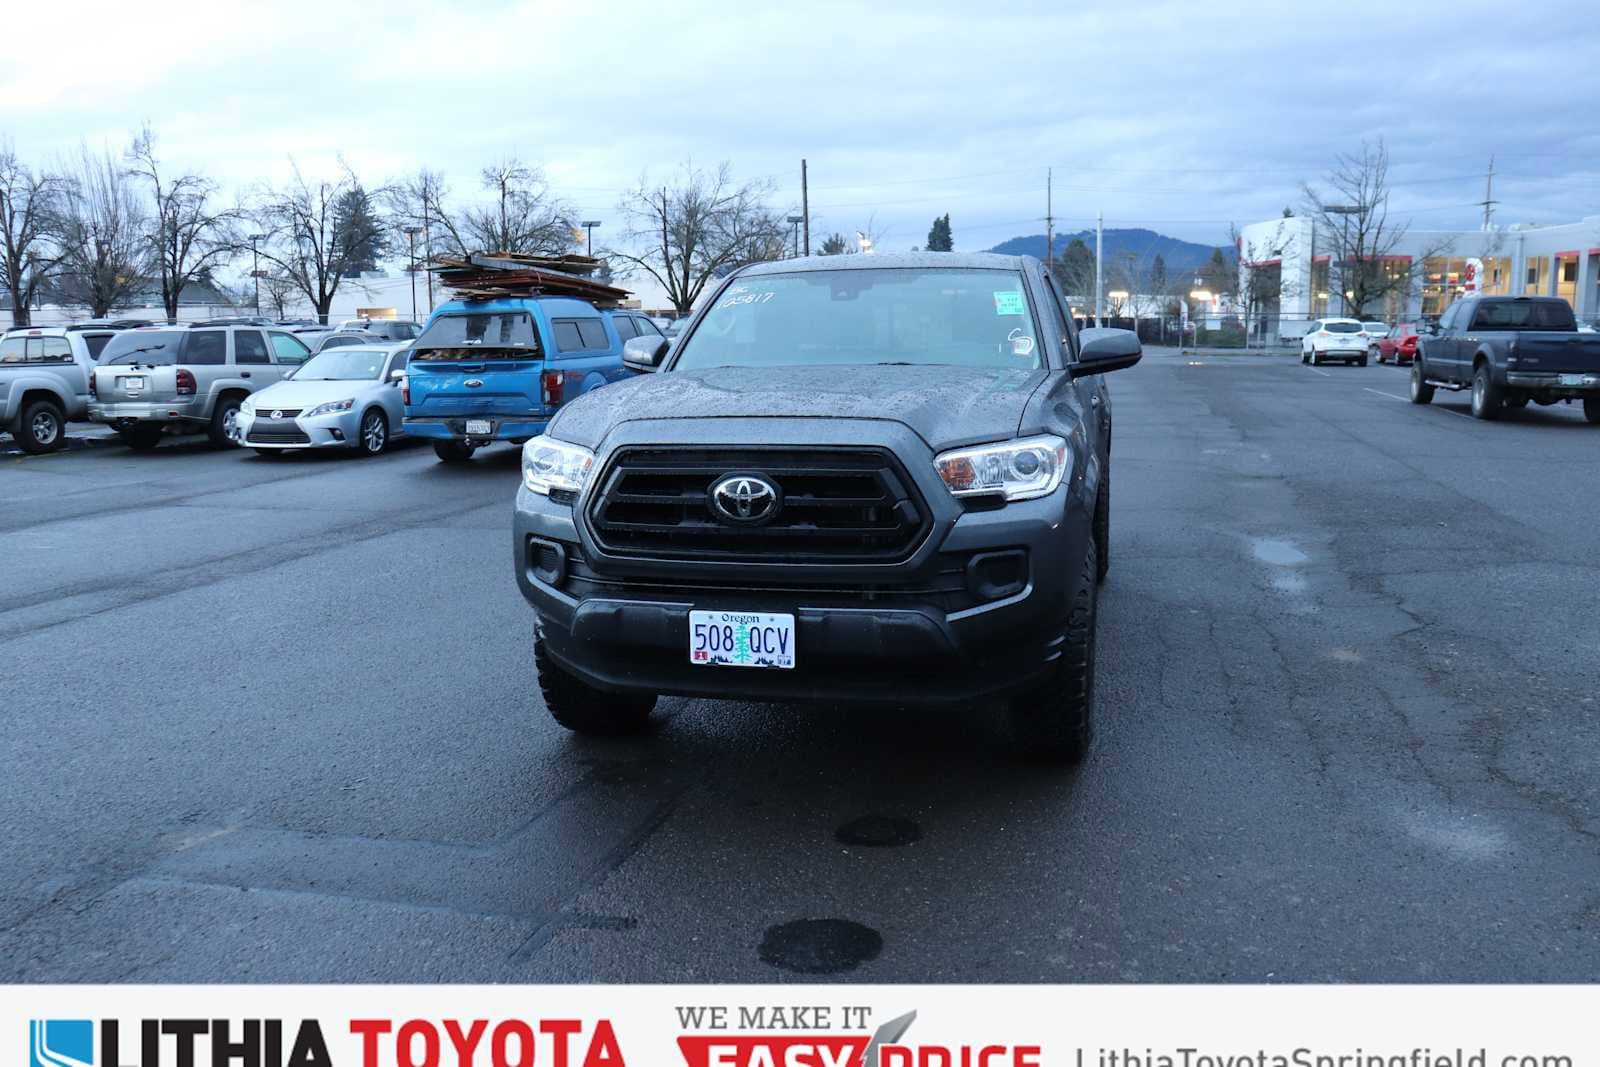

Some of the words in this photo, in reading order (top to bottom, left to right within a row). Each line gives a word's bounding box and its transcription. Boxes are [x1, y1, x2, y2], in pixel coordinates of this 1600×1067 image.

[721, 613, 760, 624] Oregon
[695, 624, 734, 652] 508
[749, 626, 789, 655] QCV
